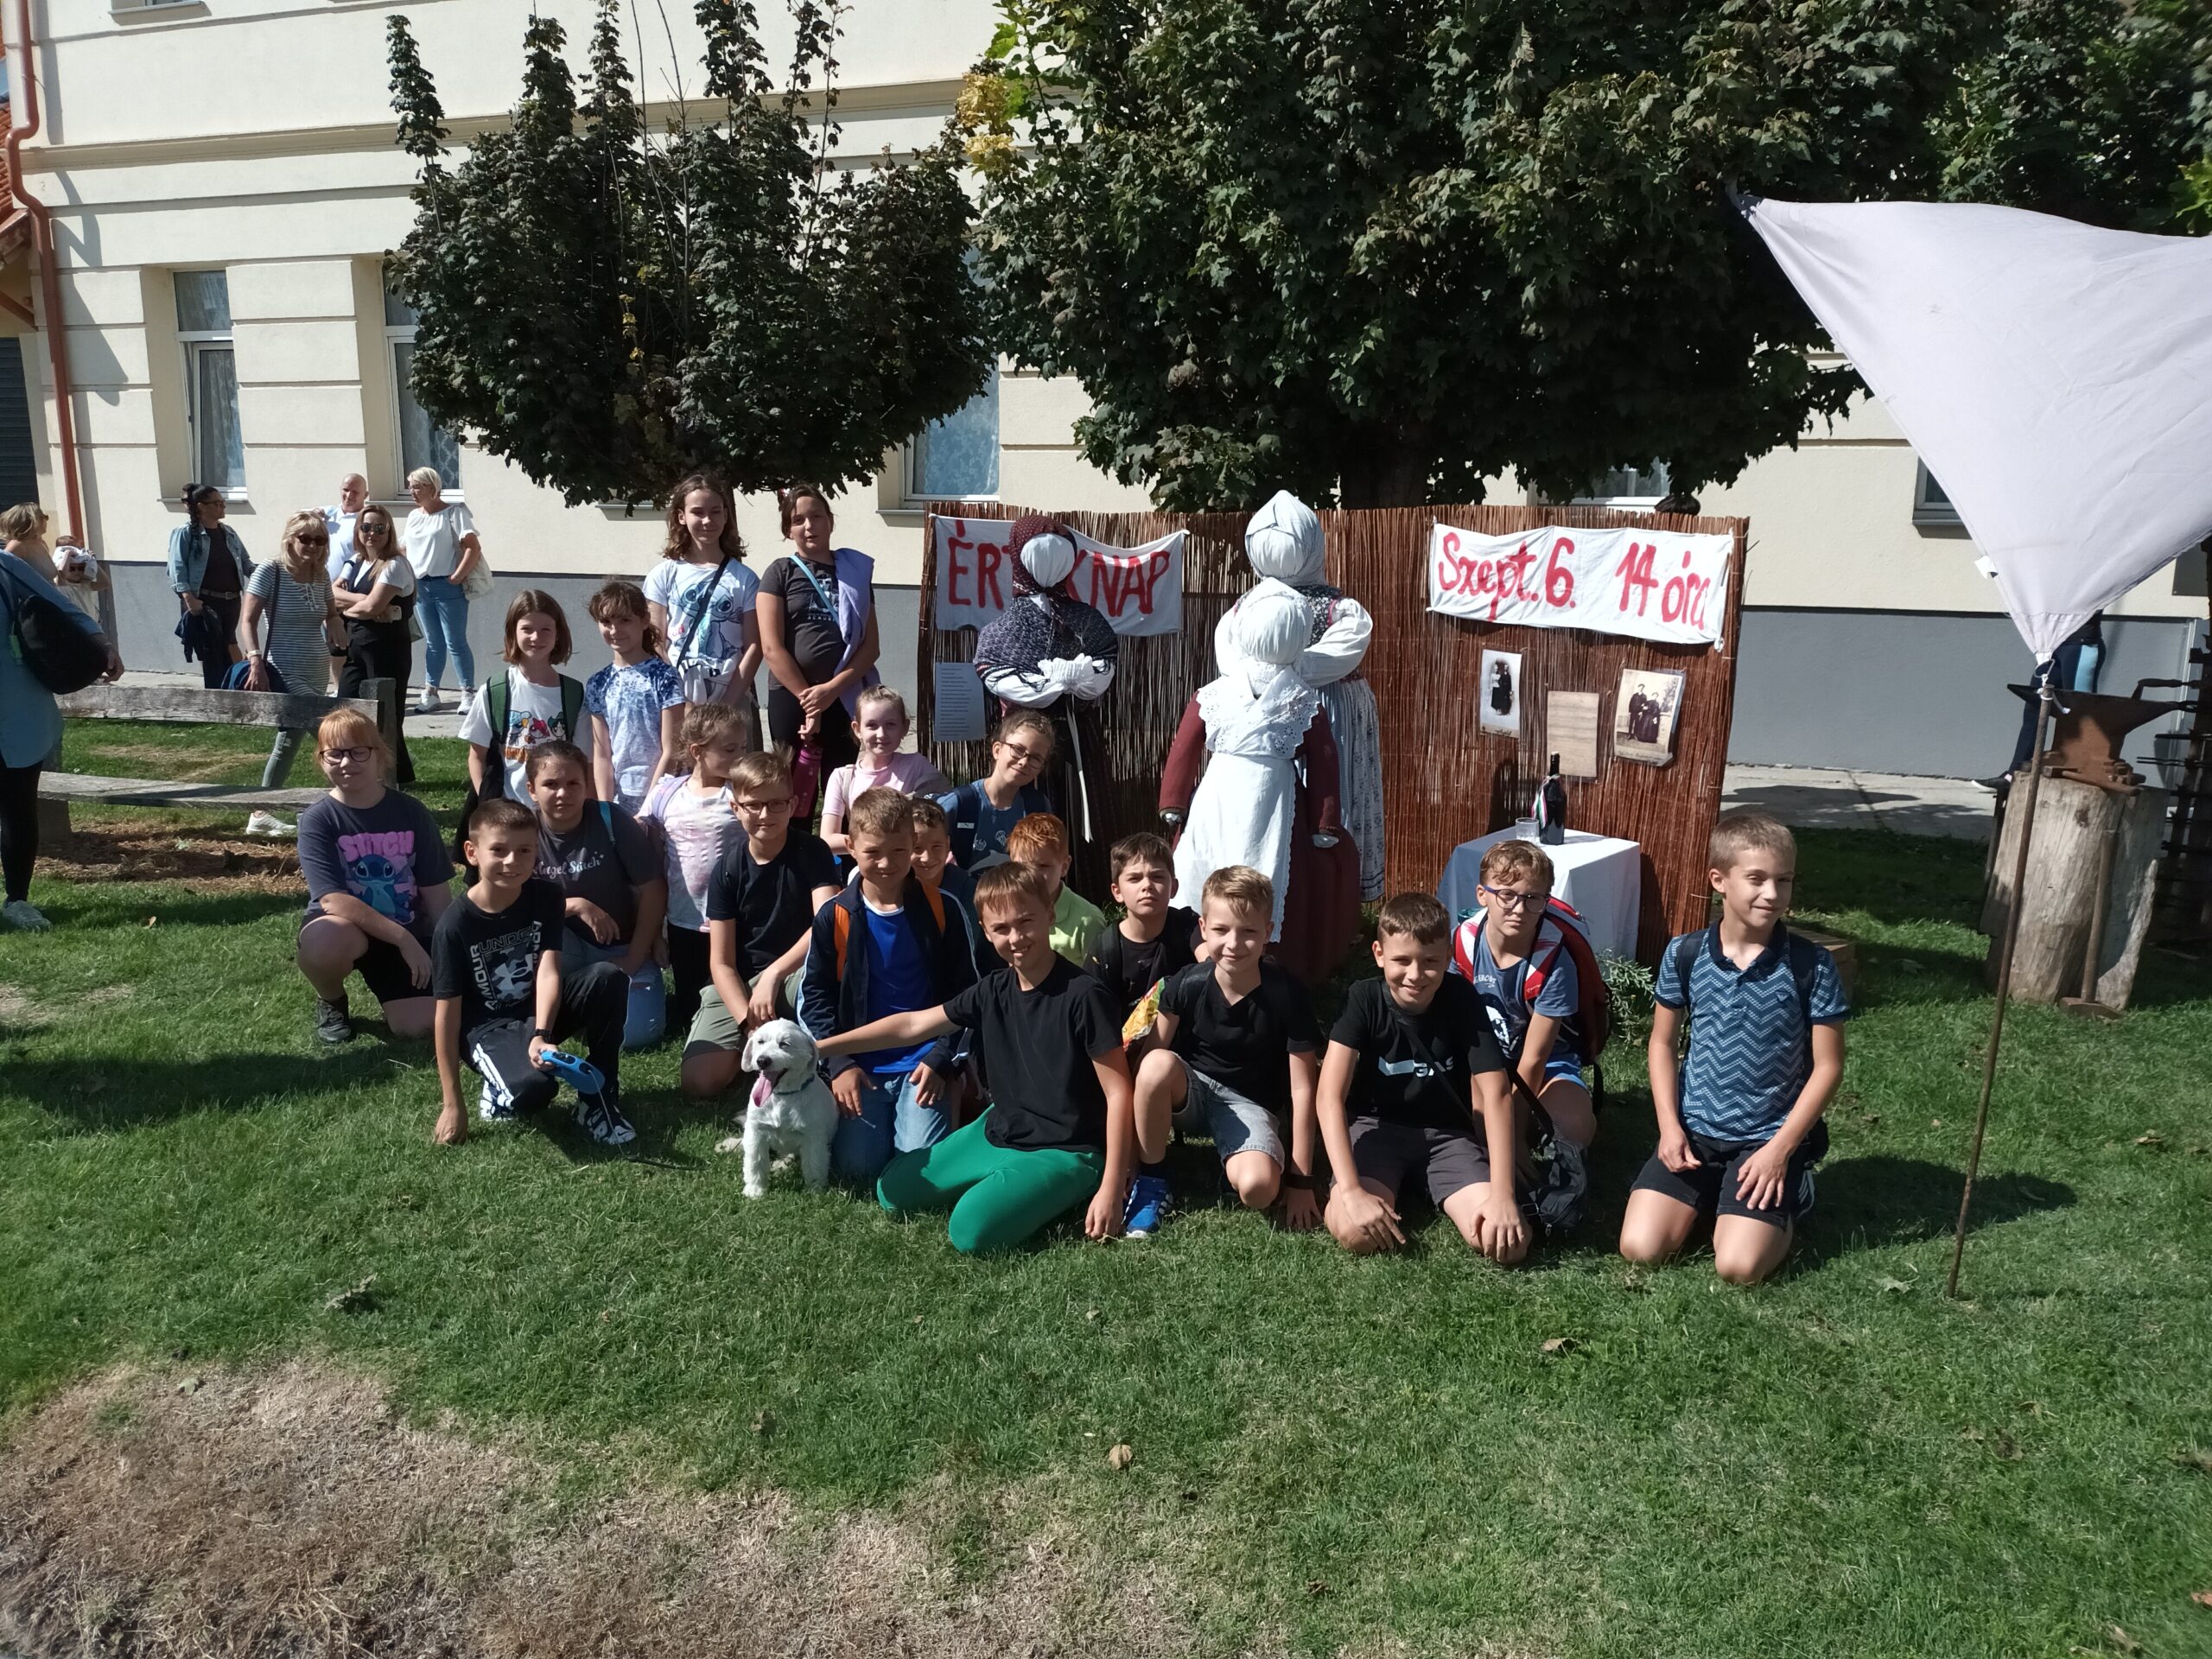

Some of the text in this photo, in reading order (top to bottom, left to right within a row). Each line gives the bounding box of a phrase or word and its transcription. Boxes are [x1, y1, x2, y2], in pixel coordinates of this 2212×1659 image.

[1438, 531, 1538, 622] Szept.
[1545, 537, 1576, 608] 6.
[1616, 542, 1659, 617] 14
[338, 830, 415, 862] STITCH
[470, 944, 499, 1011] AMOUR
